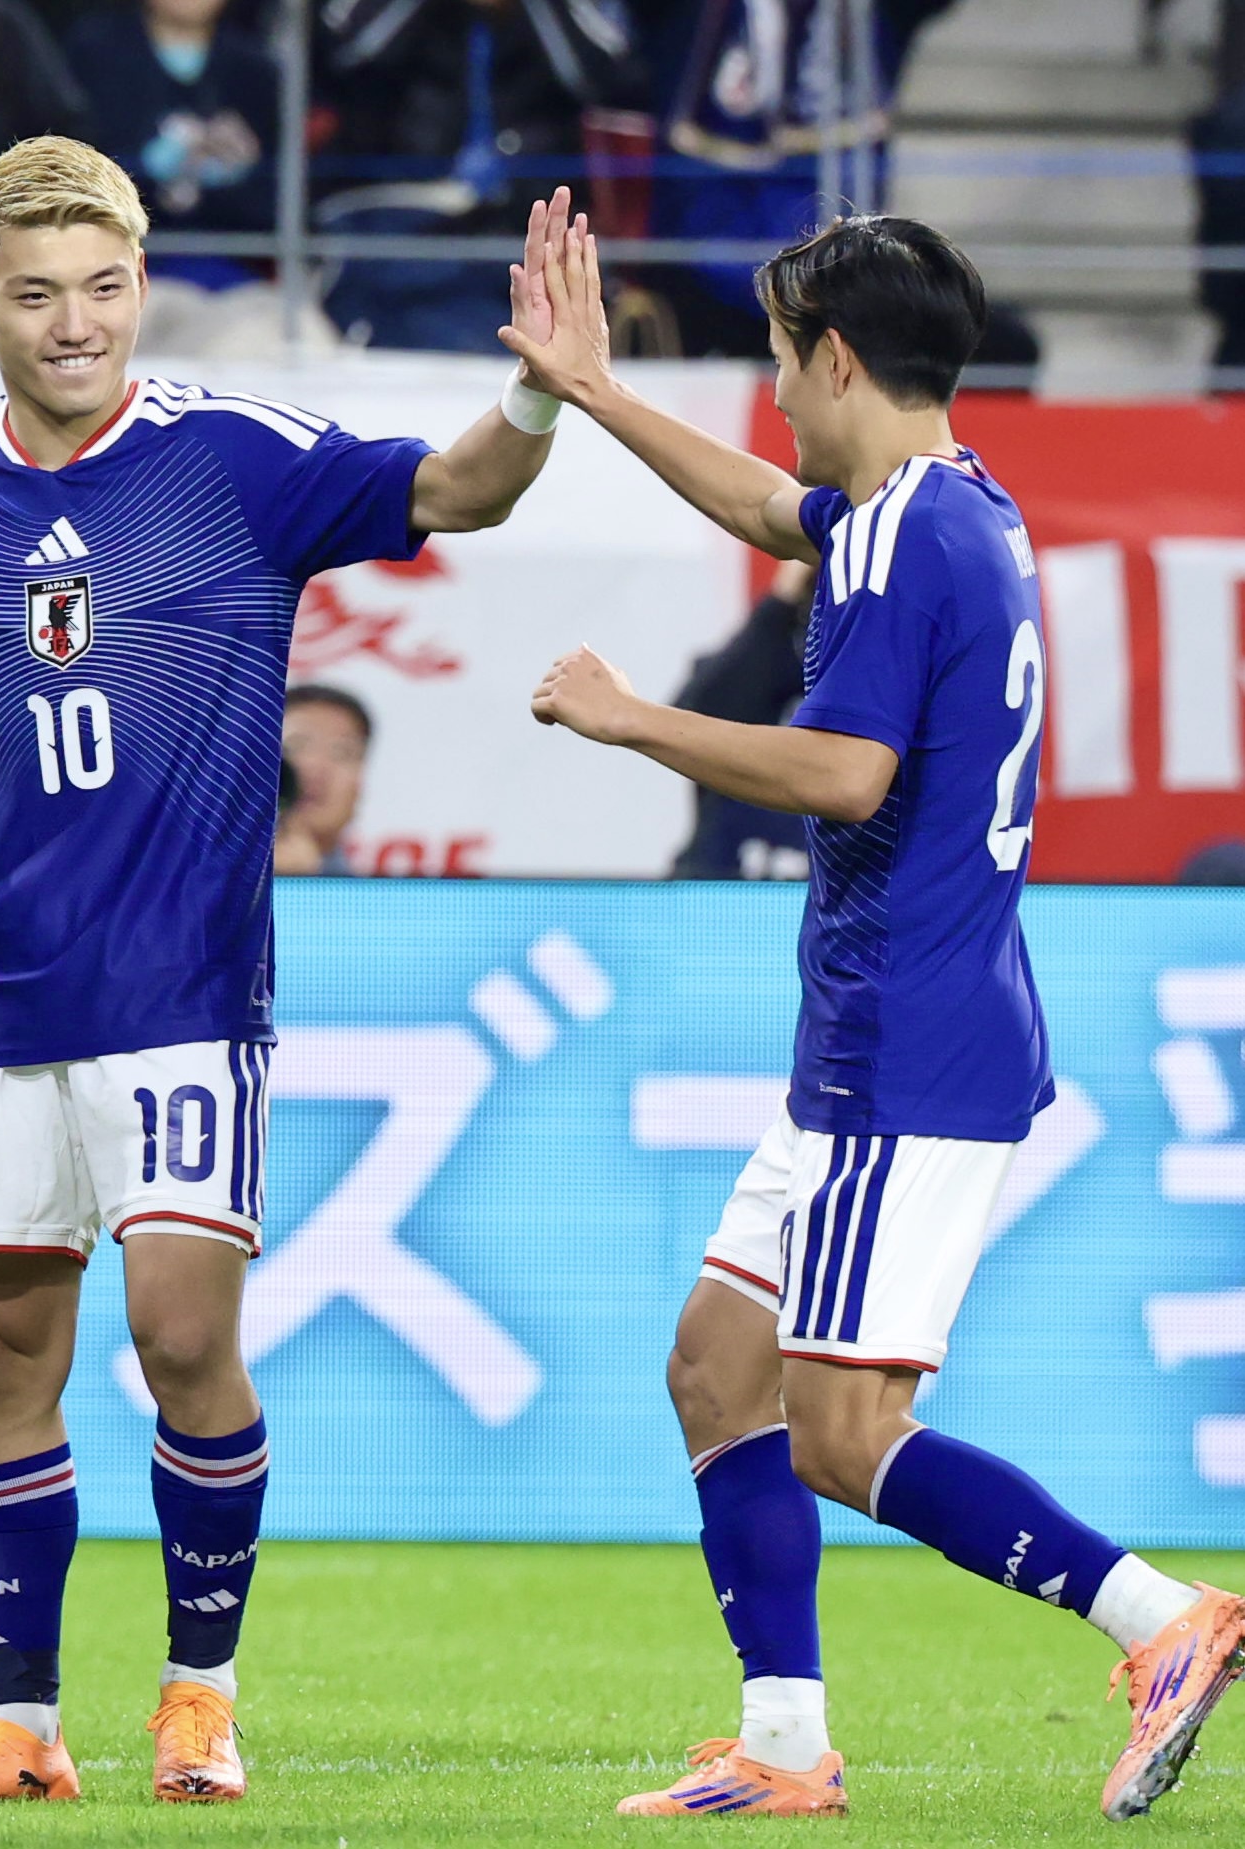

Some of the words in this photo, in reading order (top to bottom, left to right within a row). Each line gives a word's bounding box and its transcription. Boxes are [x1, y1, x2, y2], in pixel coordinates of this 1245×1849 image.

[41, 580, 75, 592] JAPAN
[27, 687, 115, 795] 10
[133, 1084, 217, 1184] 10
